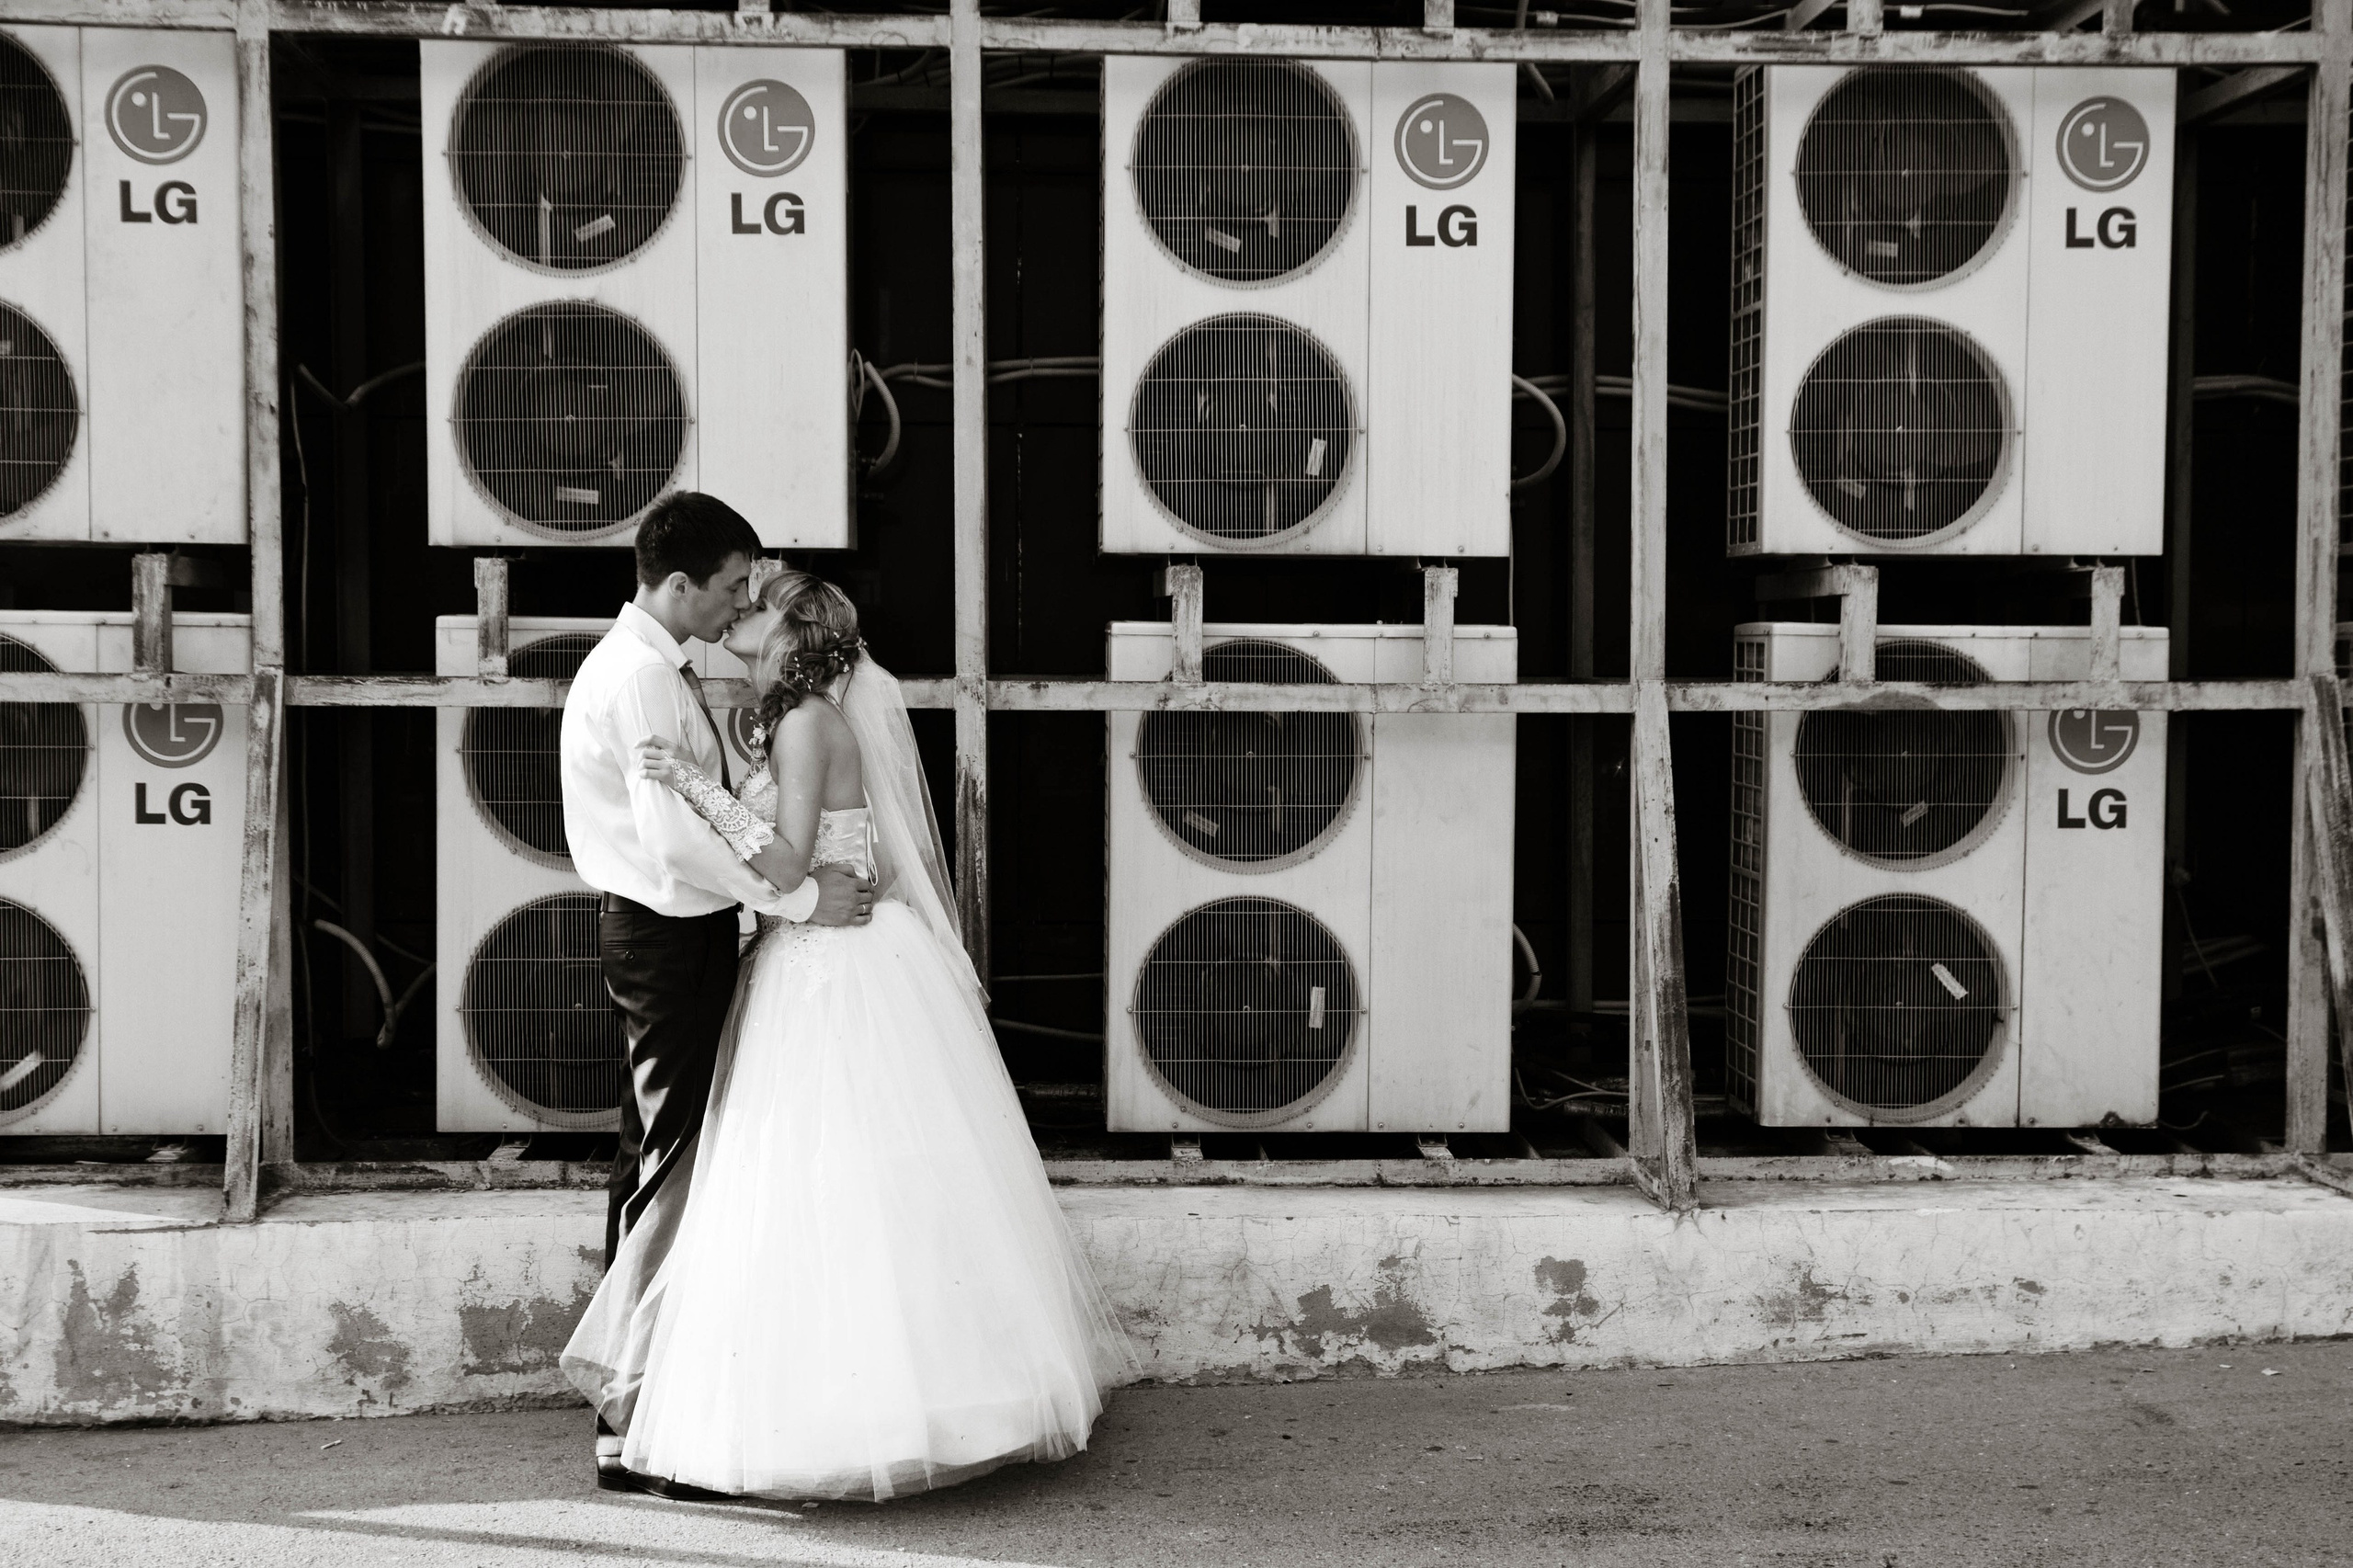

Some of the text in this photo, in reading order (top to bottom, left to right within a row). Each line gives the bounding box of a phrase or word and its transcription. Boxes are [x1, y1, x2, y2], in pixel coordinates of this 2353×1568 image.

[108, 69, 205, 164] LG
[721, 83, 813, 175] LG
[1397, 97, 1486, 187] LG
[2059, 98, 2146, 189] LG
[120, 181, 197, 224] LG
[732, 193, 804, 234] LG
[1406, 205, 1477, 247] LG
[2066, 208, 2136, 248] LG
[136, 783, 210, 825] LG
[2058, 789, 2127, 829] LG
